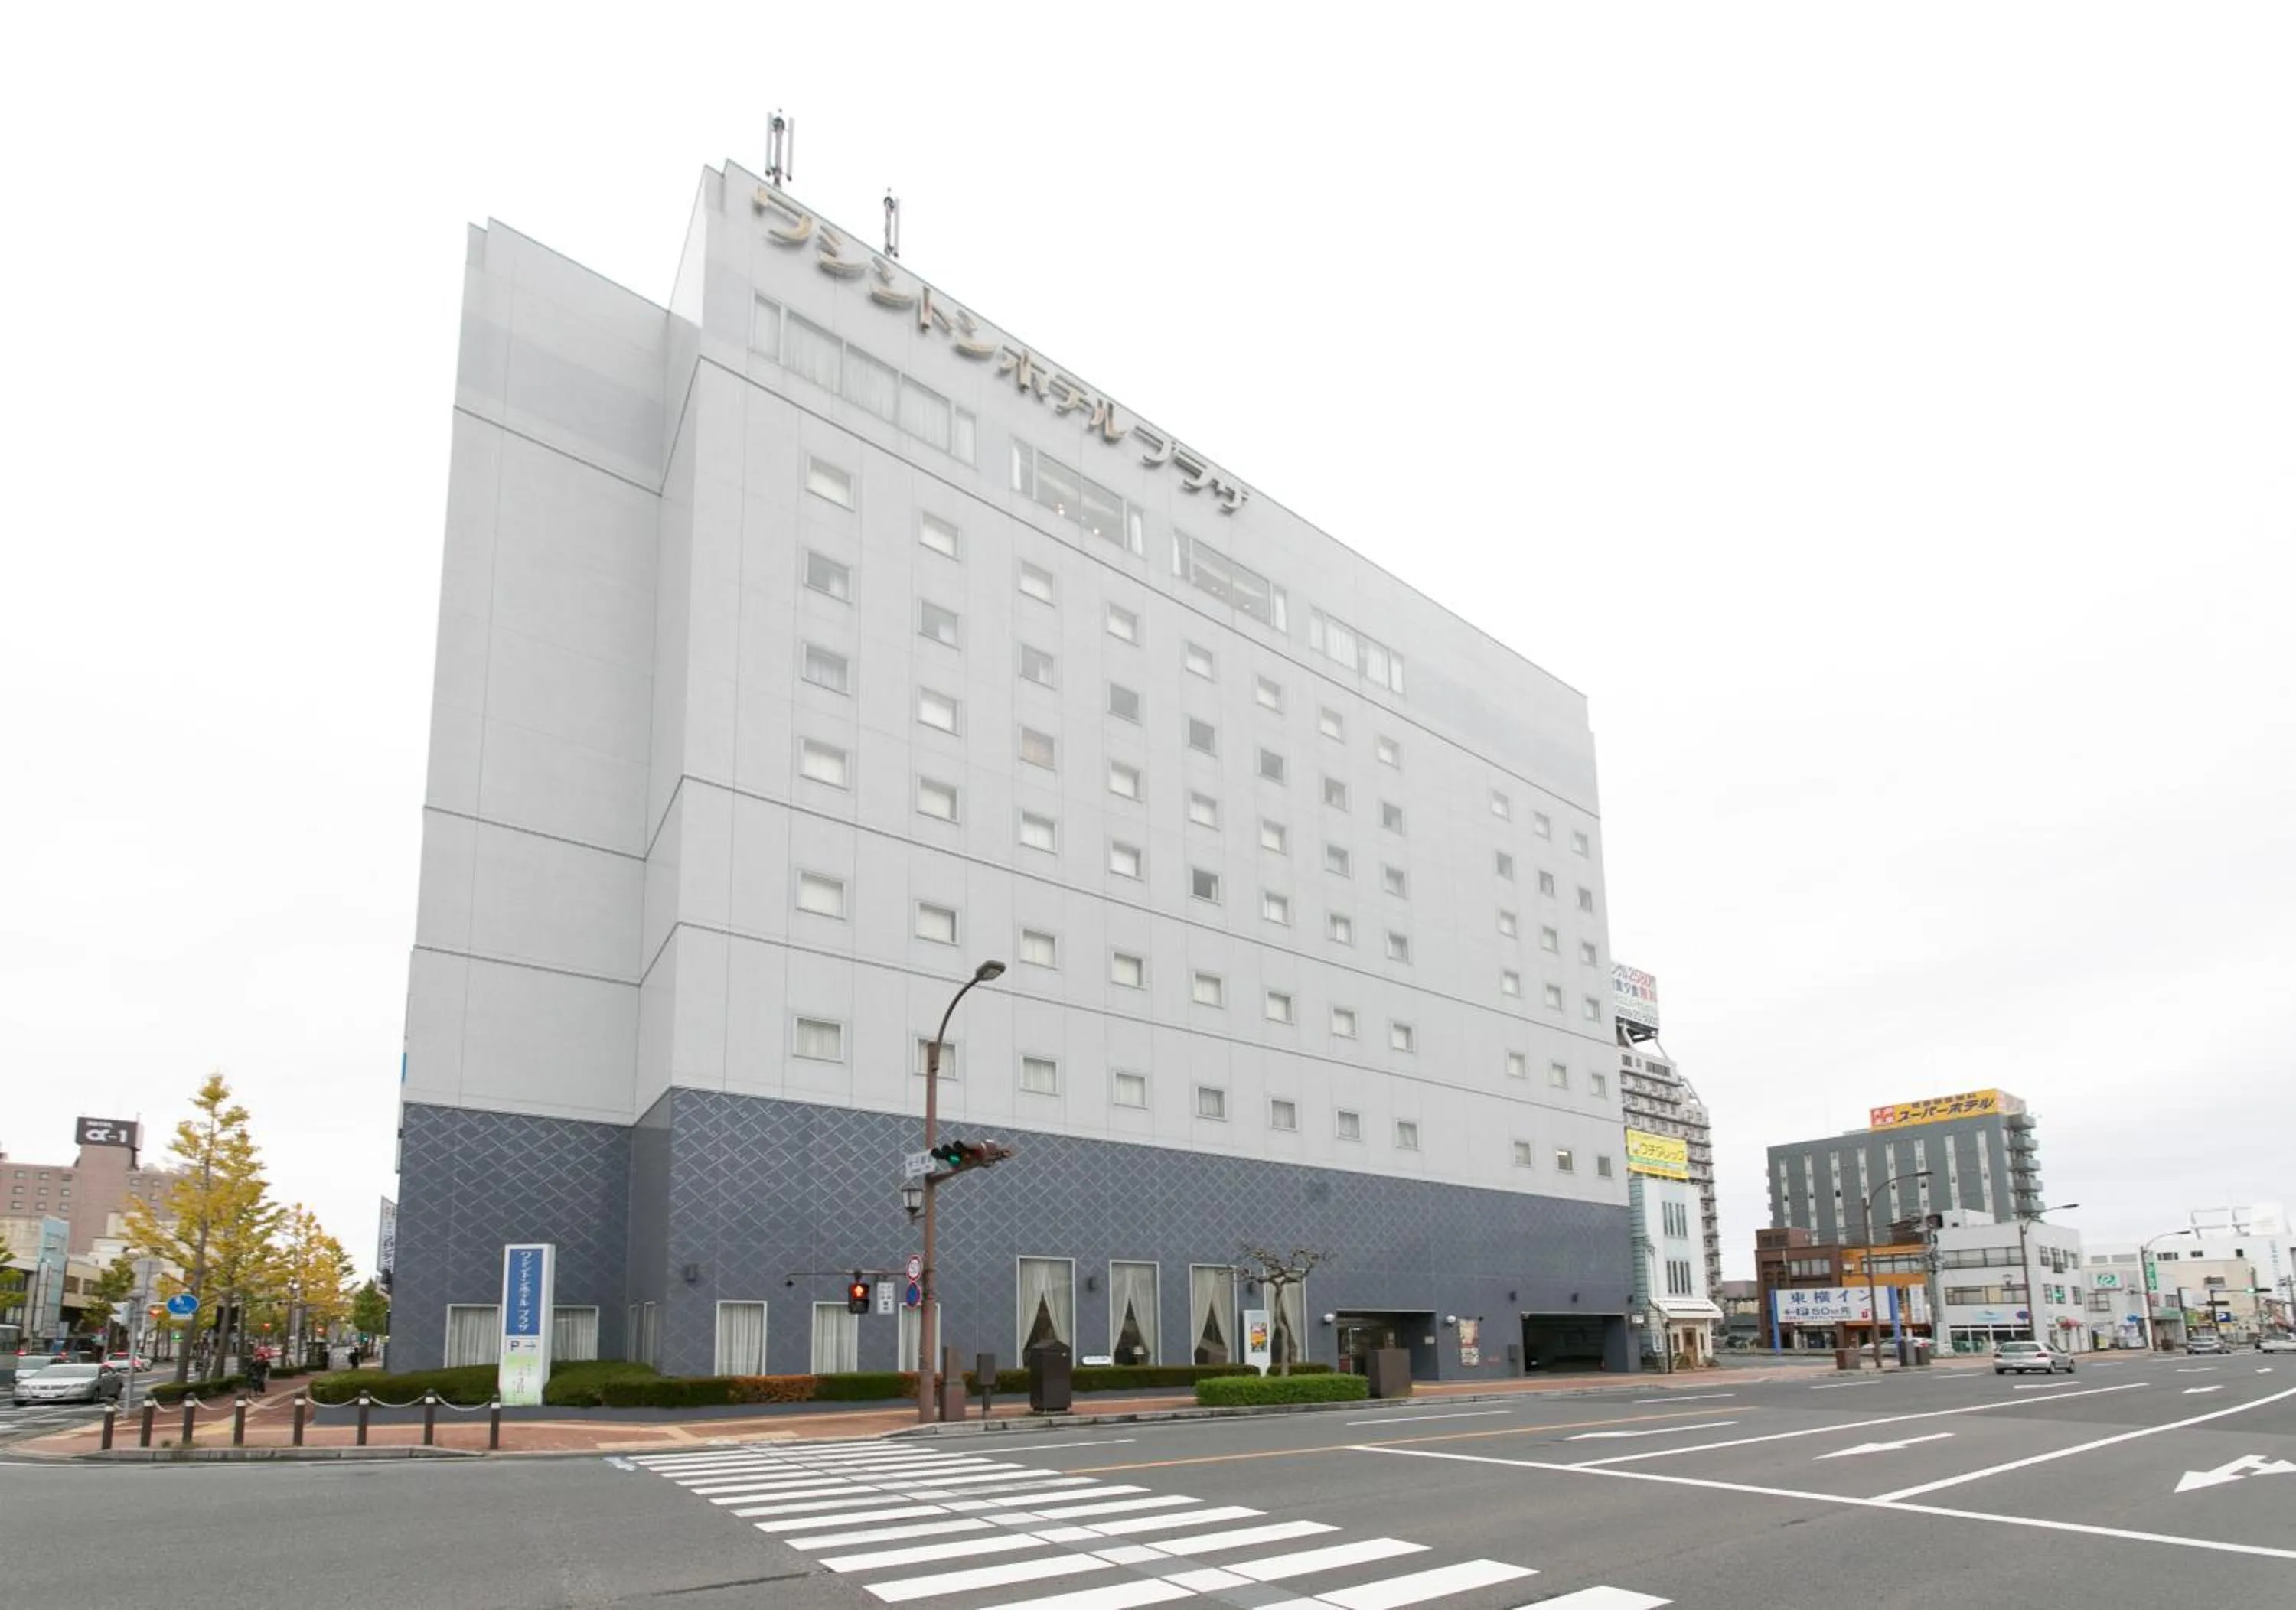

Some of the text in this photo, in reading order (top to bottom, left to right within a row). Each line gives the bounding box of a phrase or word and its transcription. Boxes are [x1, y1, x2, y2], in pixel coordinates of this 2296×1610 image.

[1898, 1098, 1994, 1122] スーパーホテル
[1791, 1289, 1872, 1304] 東横イン
[511, 1340, 520, 1351] P
